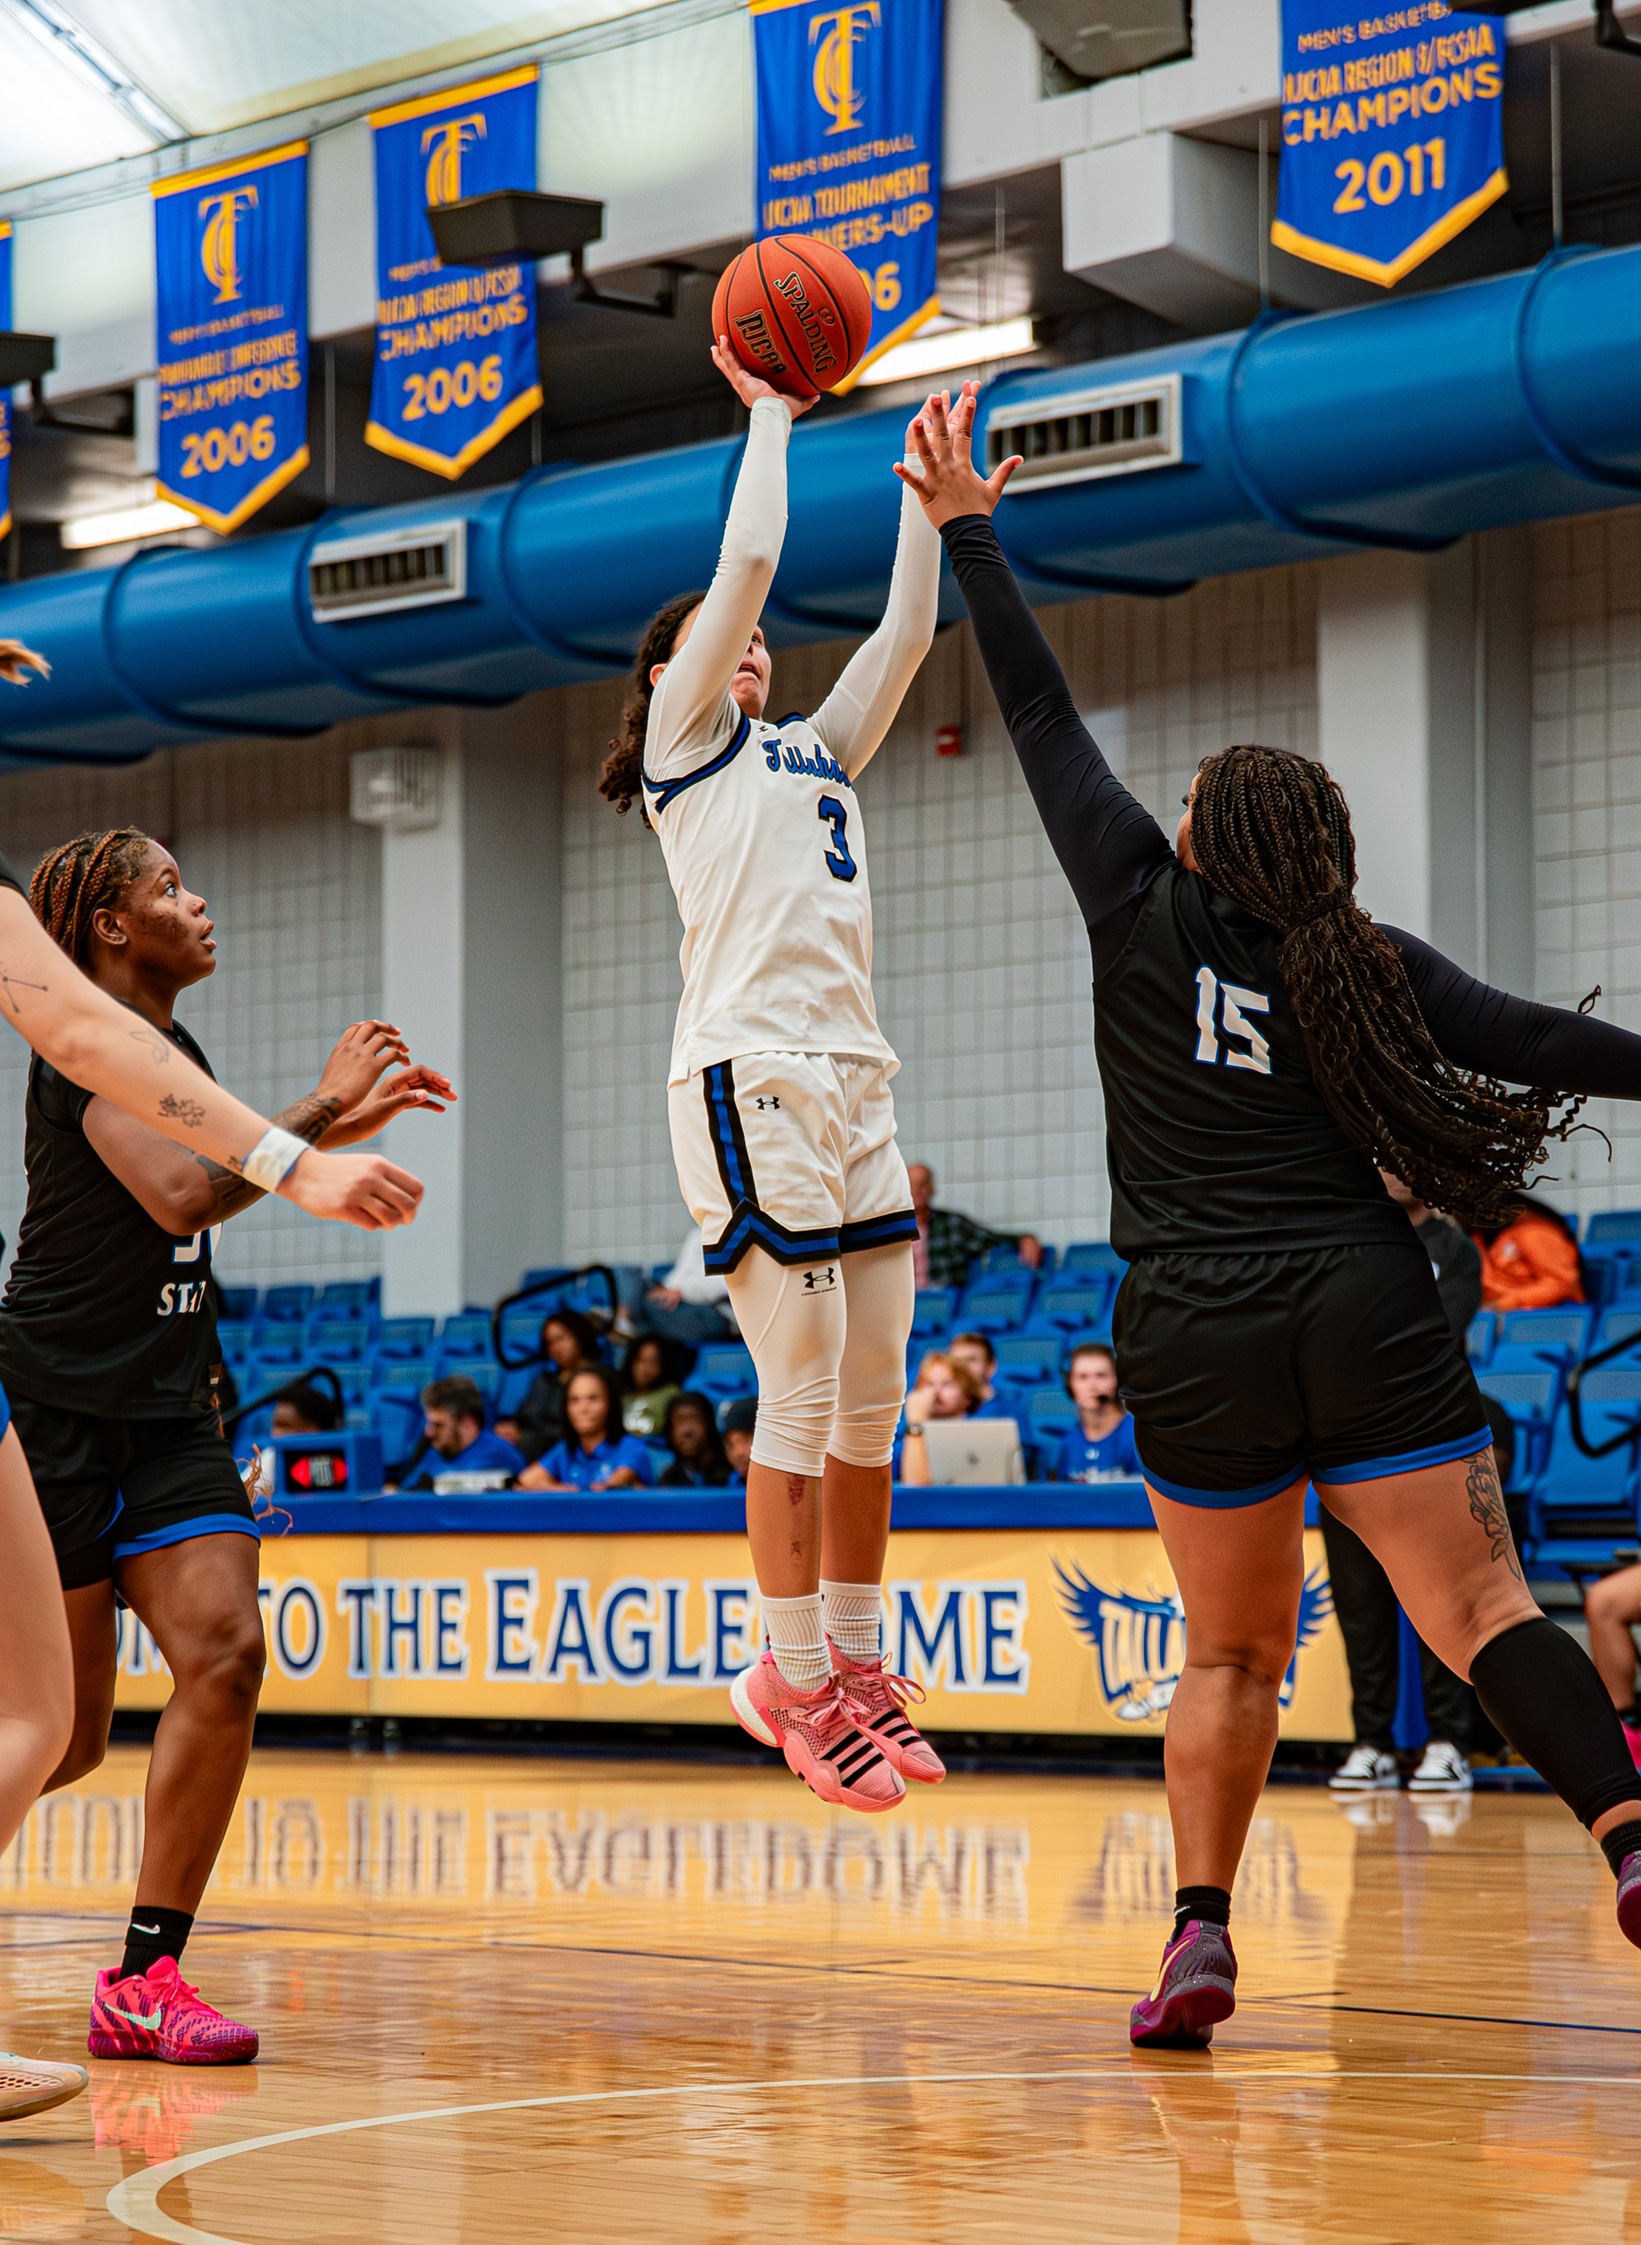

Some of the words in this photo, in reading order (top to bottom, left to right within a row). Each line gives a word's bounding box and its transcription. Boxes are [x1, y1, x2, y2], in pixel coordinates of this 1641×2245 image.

[1283, 62, 1503, 146] CHAMPIONS
[1344, 47, 1415, 92] REGION
[1332, 136, 1446, 215] 2011
[732, 308, 788, 375] NJCAA
[773, 271, 839, 374] SPALDING
[402, 354, 503, 421] 2006
[179, 414, 276, 479] 2006
[818, 794, 857, 882] 3
[1194, 965, 1273, 1075] 15
[337, 1578, 468, 1680] THE
